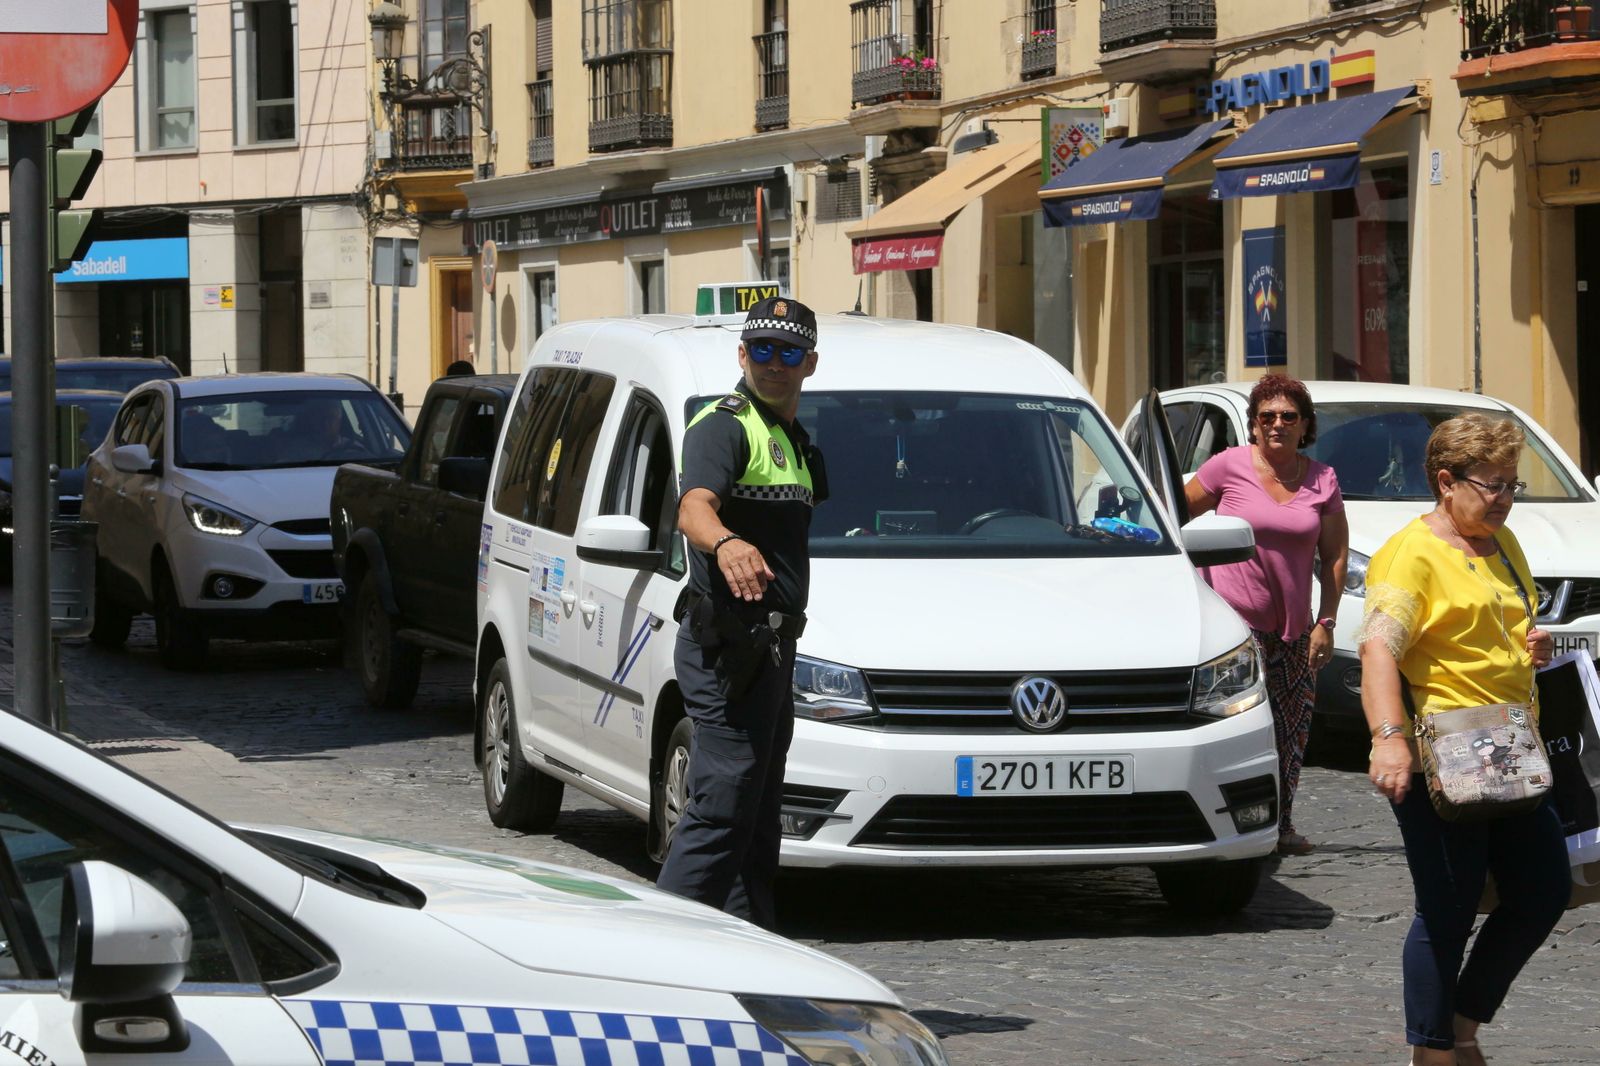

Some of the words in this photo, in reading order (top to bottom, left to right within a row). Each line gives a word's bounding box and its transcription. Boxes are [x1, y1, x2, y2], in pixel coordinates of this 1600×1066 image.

[1259, 169, 1309, 187] SPAGNOLO
[601, 199, 658, 234] OUTLET
[1082, 201, 1120, 216] SPAGNOLO
[72, 256, 127, 276] Sabadell
[632, 707, 644, 724] TAXI
[961, 780, 968, 789] E
[980, 762, 1053, 790] 2701
[1069, 761, 1124, 789] KFB
